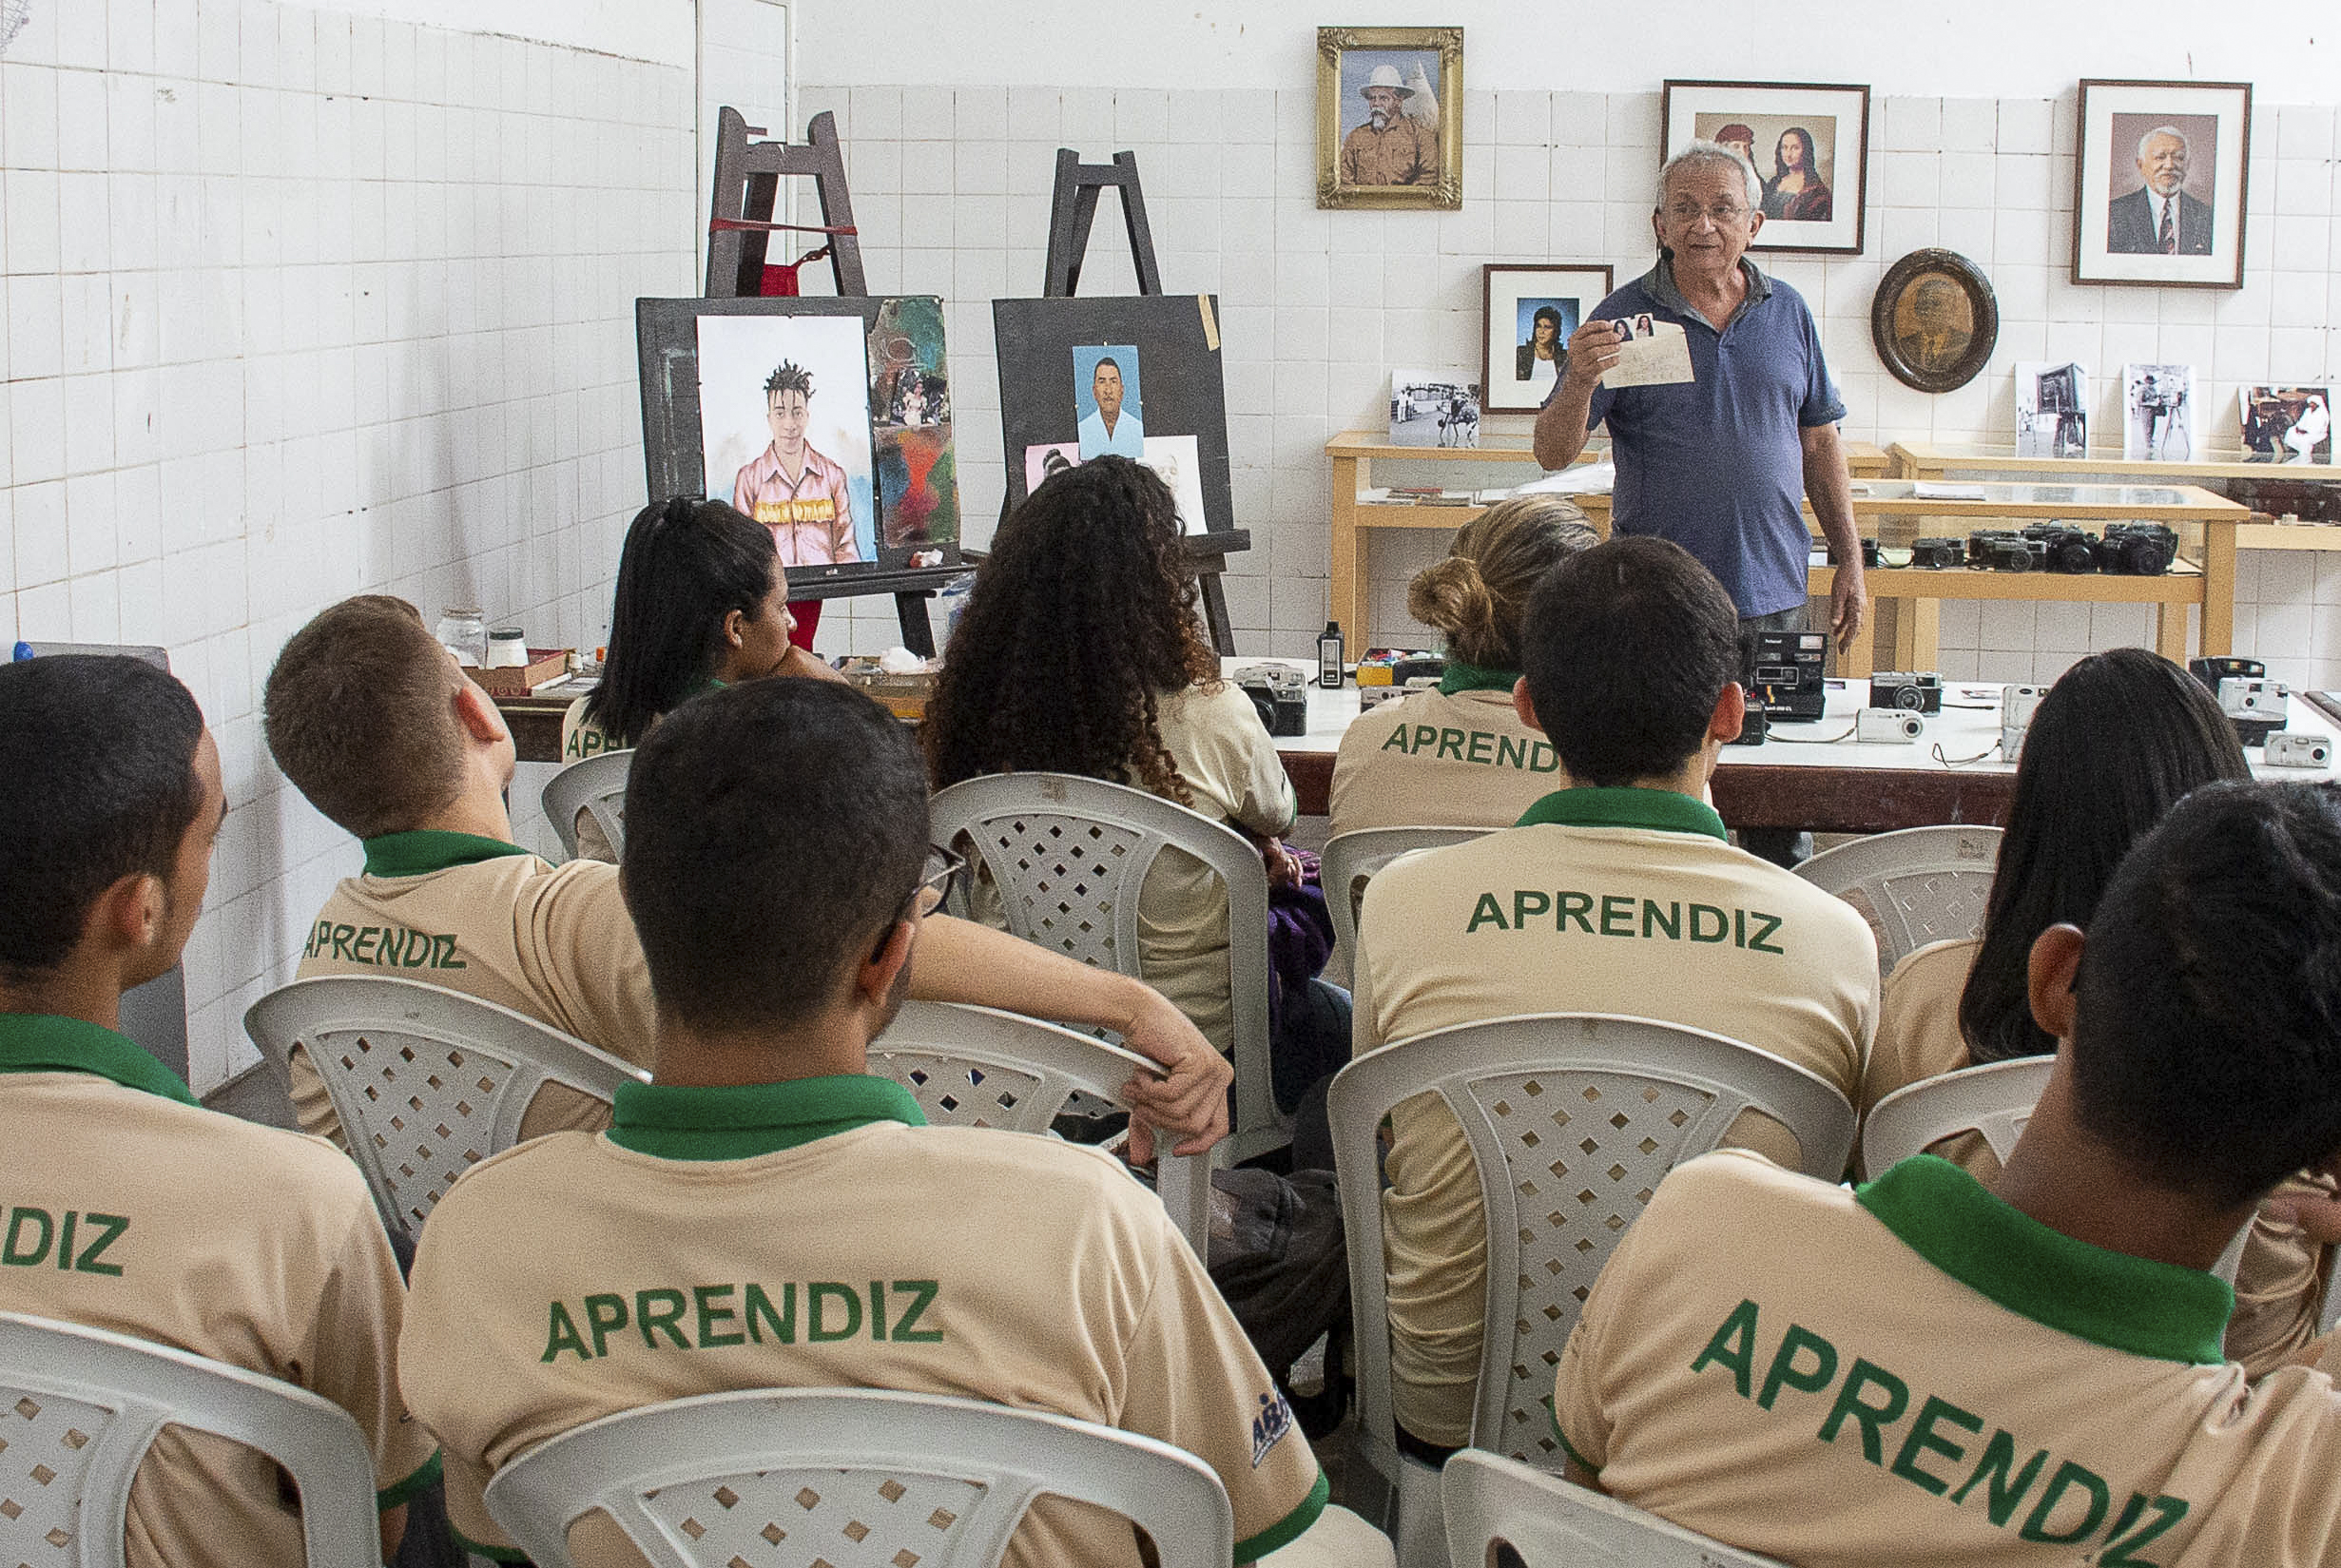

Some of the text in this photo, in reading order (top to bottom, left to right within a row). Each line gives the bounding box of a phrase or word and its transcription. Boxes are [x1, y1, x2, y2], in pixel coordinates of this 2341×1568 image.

[1382, 723, 1559, 773] APREND
[302, 920, 468, 969] APRENDIZ
[1466, 890, 1785, 955] APRENDIZ
[0, 1205, 129, 1277] DIZ
[539, 1280, 944, 1364] APRENDIZ
[1690, 1298, 2190, 1568] APRENDIZ
